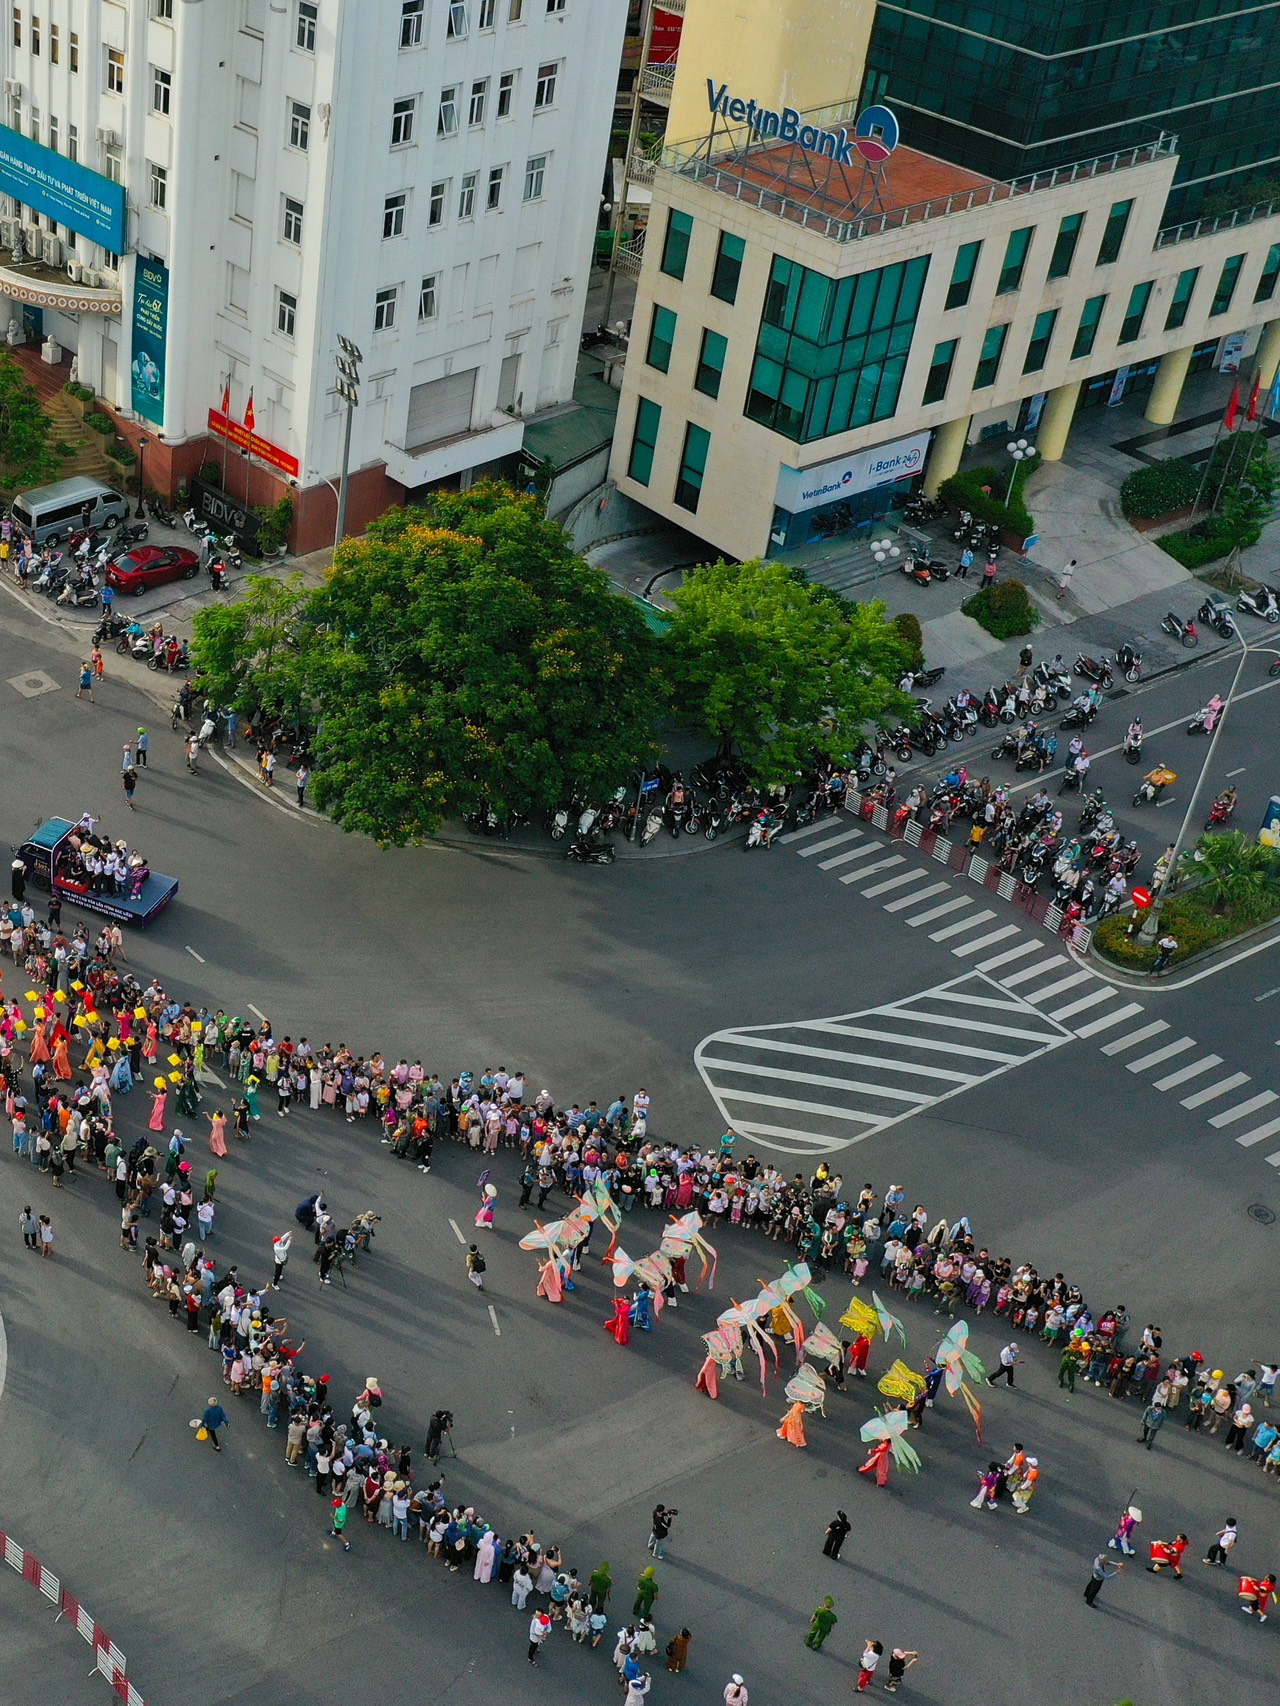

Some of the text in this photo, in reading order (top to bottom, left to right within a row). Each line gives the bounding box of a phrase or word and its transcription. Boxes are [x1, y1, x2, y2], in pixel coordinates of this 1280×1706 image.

[706, 78, 857, 167] VietinBank
[10, 154, 24, 169] HÀNG
[24, 162, 37, 176] TMCP
[61, 181, 74, 196] PHÁT
[74, 189, 89, 204] TRIỂN
[88, 196, 100, 210] VIỆT
[100, 203, 112, 216] NAM
[143, 268, 157, 282] BIDV
[802, 481, 842, 500] VietinBank
[202, 491, 236, 525] BIDV
